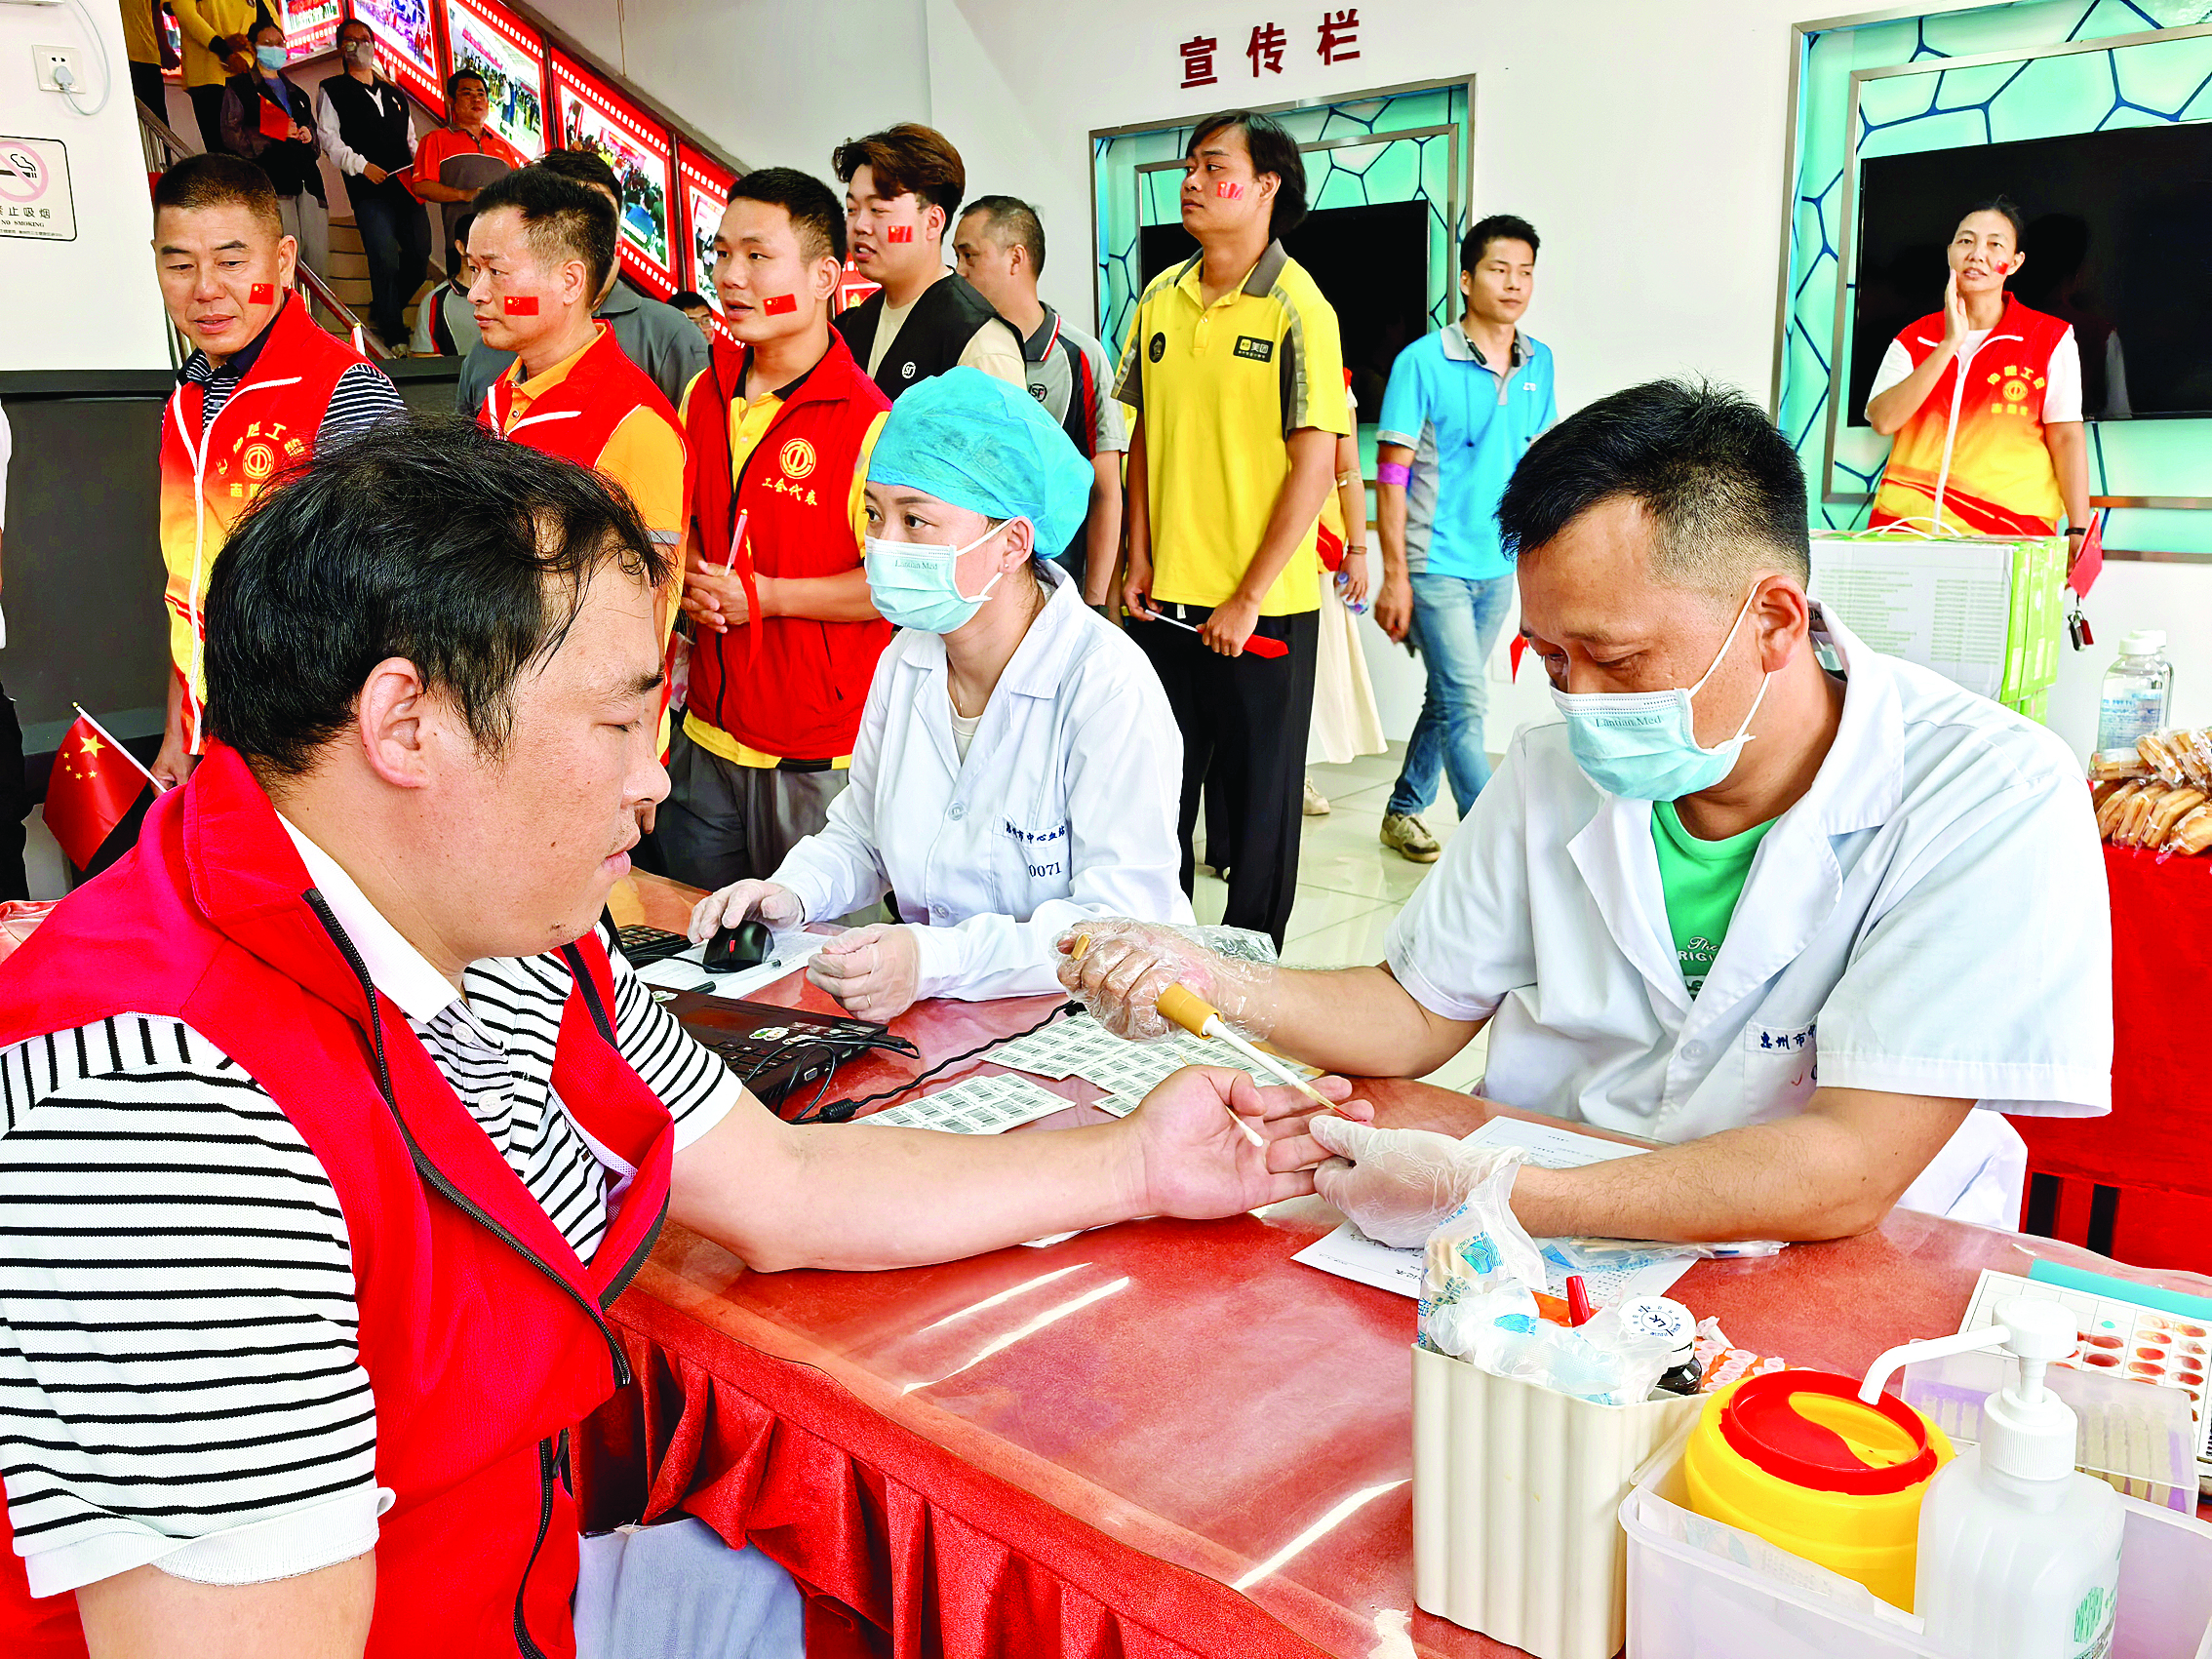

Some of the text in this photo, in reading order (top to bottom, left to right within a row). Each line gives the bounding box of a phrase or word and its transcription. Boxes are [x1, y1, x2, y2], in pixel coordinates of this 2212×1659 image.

[1175, 8, 1362, 90] 宣传栏
[1596, 715, 1662, 728] Lantian Med
[1029, 861, 1062, 877] 0071
[1687, 936, 1718, 951] The
